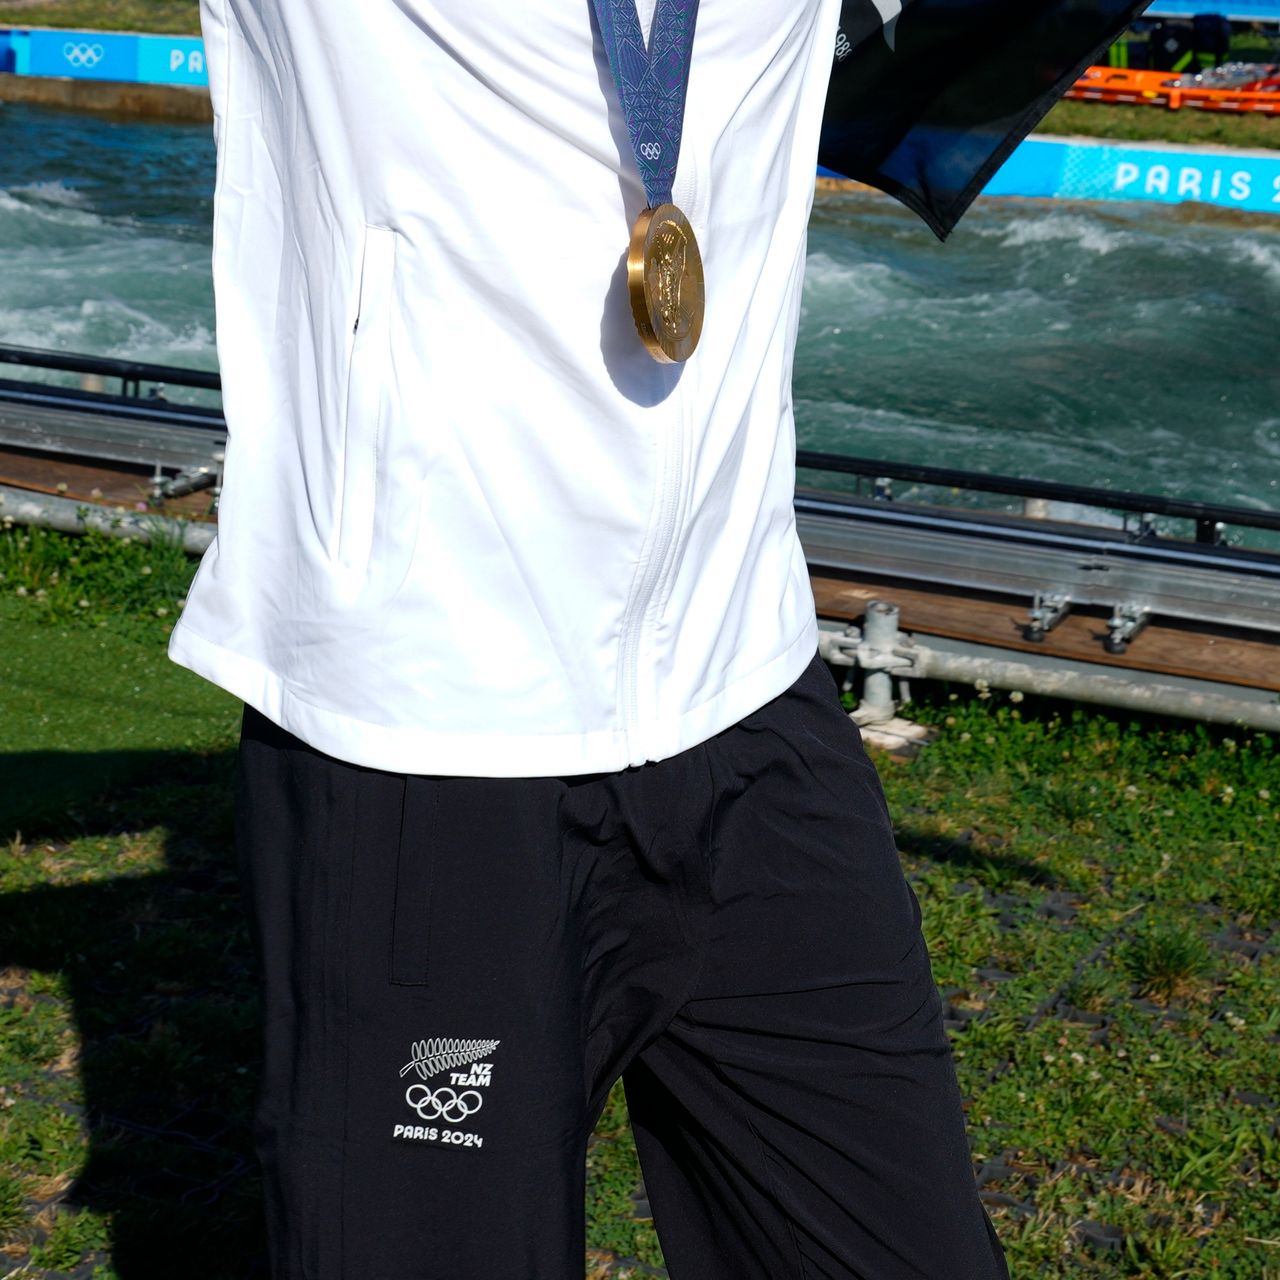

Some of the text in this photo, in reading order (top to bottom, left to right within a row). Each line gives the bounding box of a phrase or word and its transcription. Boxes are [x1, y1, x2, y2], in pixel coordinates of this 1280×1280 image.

[1115, 162, 1252, 201] PARIS
[470, 1063, 494, 1075] NZ
[449, 1073, 492, 1087] TEAM
[393, 1124, 483, 1148] PARIS 2024
